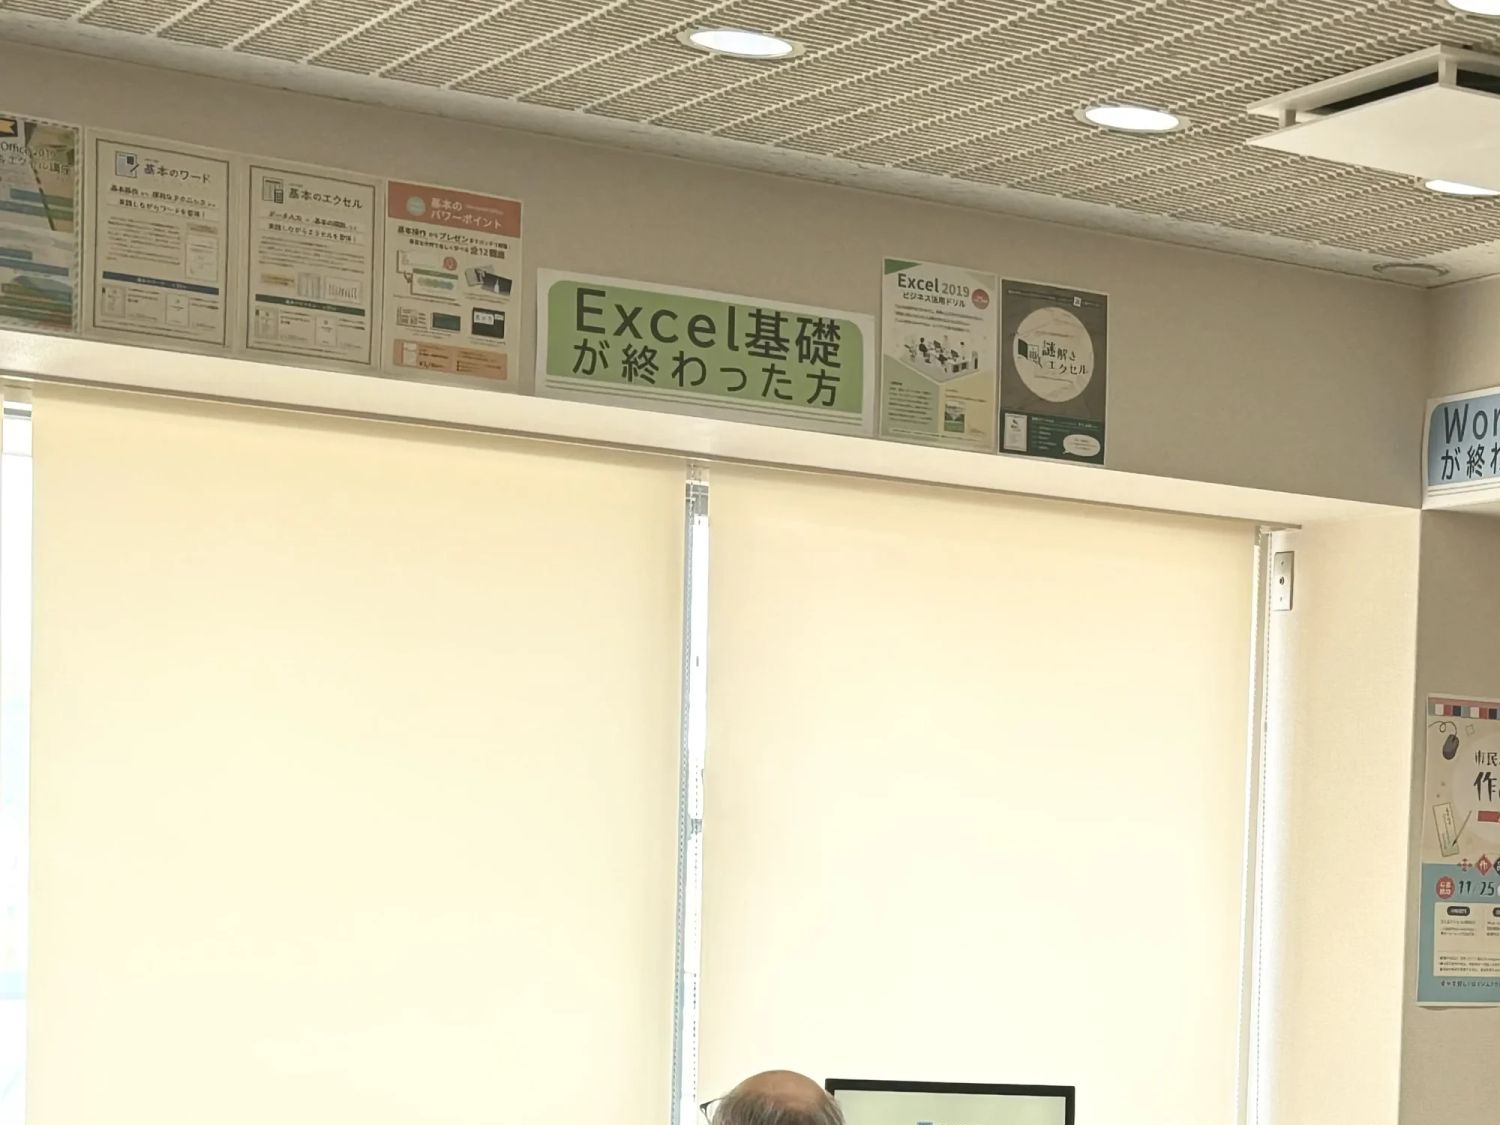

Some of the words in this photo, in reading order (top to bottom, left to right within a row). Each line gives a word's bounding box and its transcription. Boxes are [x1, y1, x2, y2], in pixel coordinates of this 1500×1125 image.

[144, 162, 210, 184] 基本のワード
[288, 187, 363, 209] 基本のエクセル
[431, 197, 462, 211] 基本の
[431, 211, 502, 230] パワーポイント
[897, 273, 940, 293] Excel
[942, 283, 970, 298] 2019
[902, 292, 966, 308] ビジネス活用ドリル
[575, 287, 843, 369] Excel基礎
[1041, 339, 1076, 360] 謎解き
[571, 338, 841, 407] が終わった方
[1048, 360, 1088, 376] エクセル
